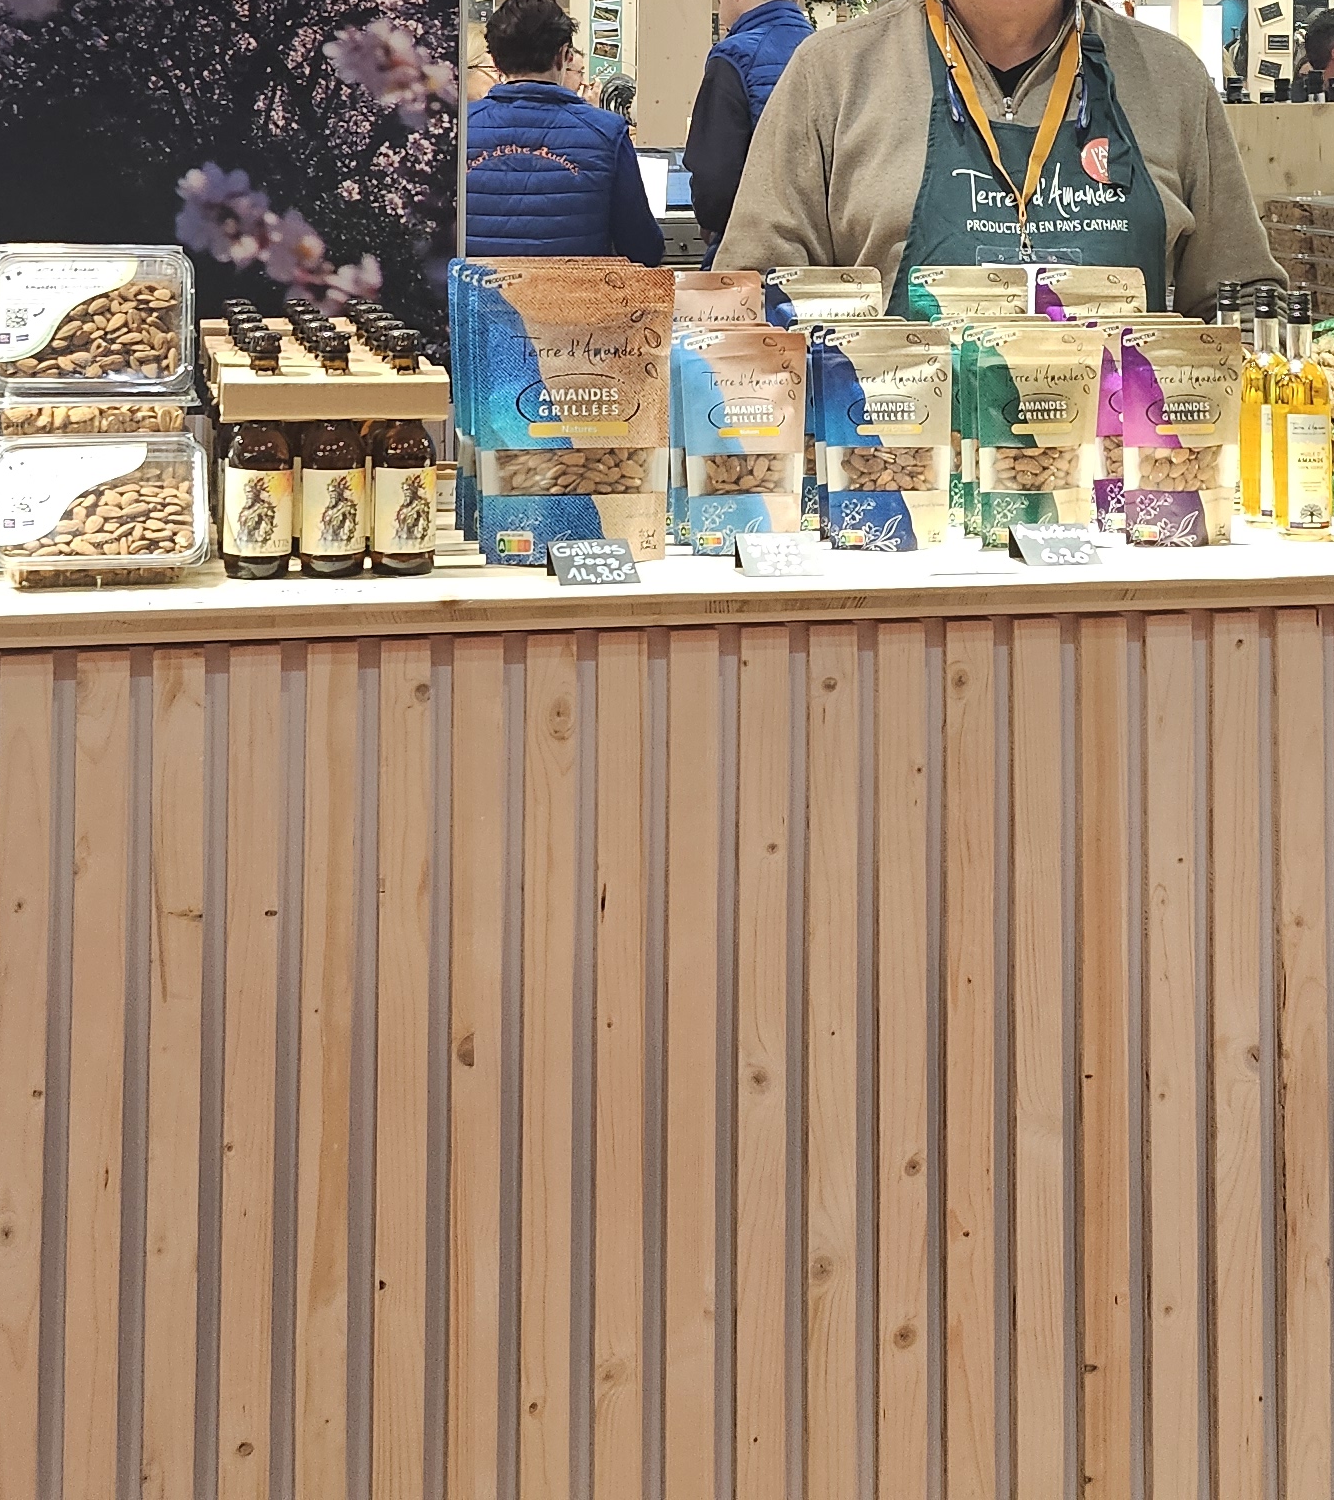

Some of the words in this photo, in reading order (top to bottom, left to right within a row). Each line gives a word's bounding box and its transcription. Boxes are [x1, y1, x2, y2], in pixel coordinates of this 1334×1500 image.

[951, 168, 1018, 213] Terre
[1032, 162, 1127, 218] d'Amandes
[1039, 220, 1055, 233] EN
[1056, 220, 1082, 232] PAYS
[1083, 219, 1129, 232] CATHARE
[484, 273, 523, 285] PRODUCTEUR
[769, 270, 798, 282] PRODUCTEUR
[913, 270, 944, 281] PRODUCTEUR
[673, 310, 696, 322] erre
[827, 331, 860, 343] PRODUCTEUR
[1125, 332, 1156, 344] PRODUCTEUR
[510, 334, 561, 364] Terre
[567, 333, 643, 366] d'Amandes
[701, 371, 735, 391] Terre
[738, 368, 789, 392] d'Amandes
[880, 365, 935, 389] d'Amandes
[1033, 364, 1085, 388] d'Amandes
[1178, 365, 1227, 389] d'Amandes
[538, 387, 619, 402] AMANDES
[538, 403, 619, 417] GRILLÉES
[724, 404, 774, 414] AMANDES
[864, 402, 916, 411] AMANDES
[1018, 401, 1067, 410] AMANDES
[1162, 402, 1210, 412] AMANDES
[724, 413, 774, 423] GRILLÉES
[864, 411, 916, 421] GRILLÉES
[1018, 409, 1068, 420] GRILLÉES
[1161, 411, 1210, 421] GRILLÉES
[573, 555, 620, 568] 500g
[567, 563, 636, 583] 14,80€
